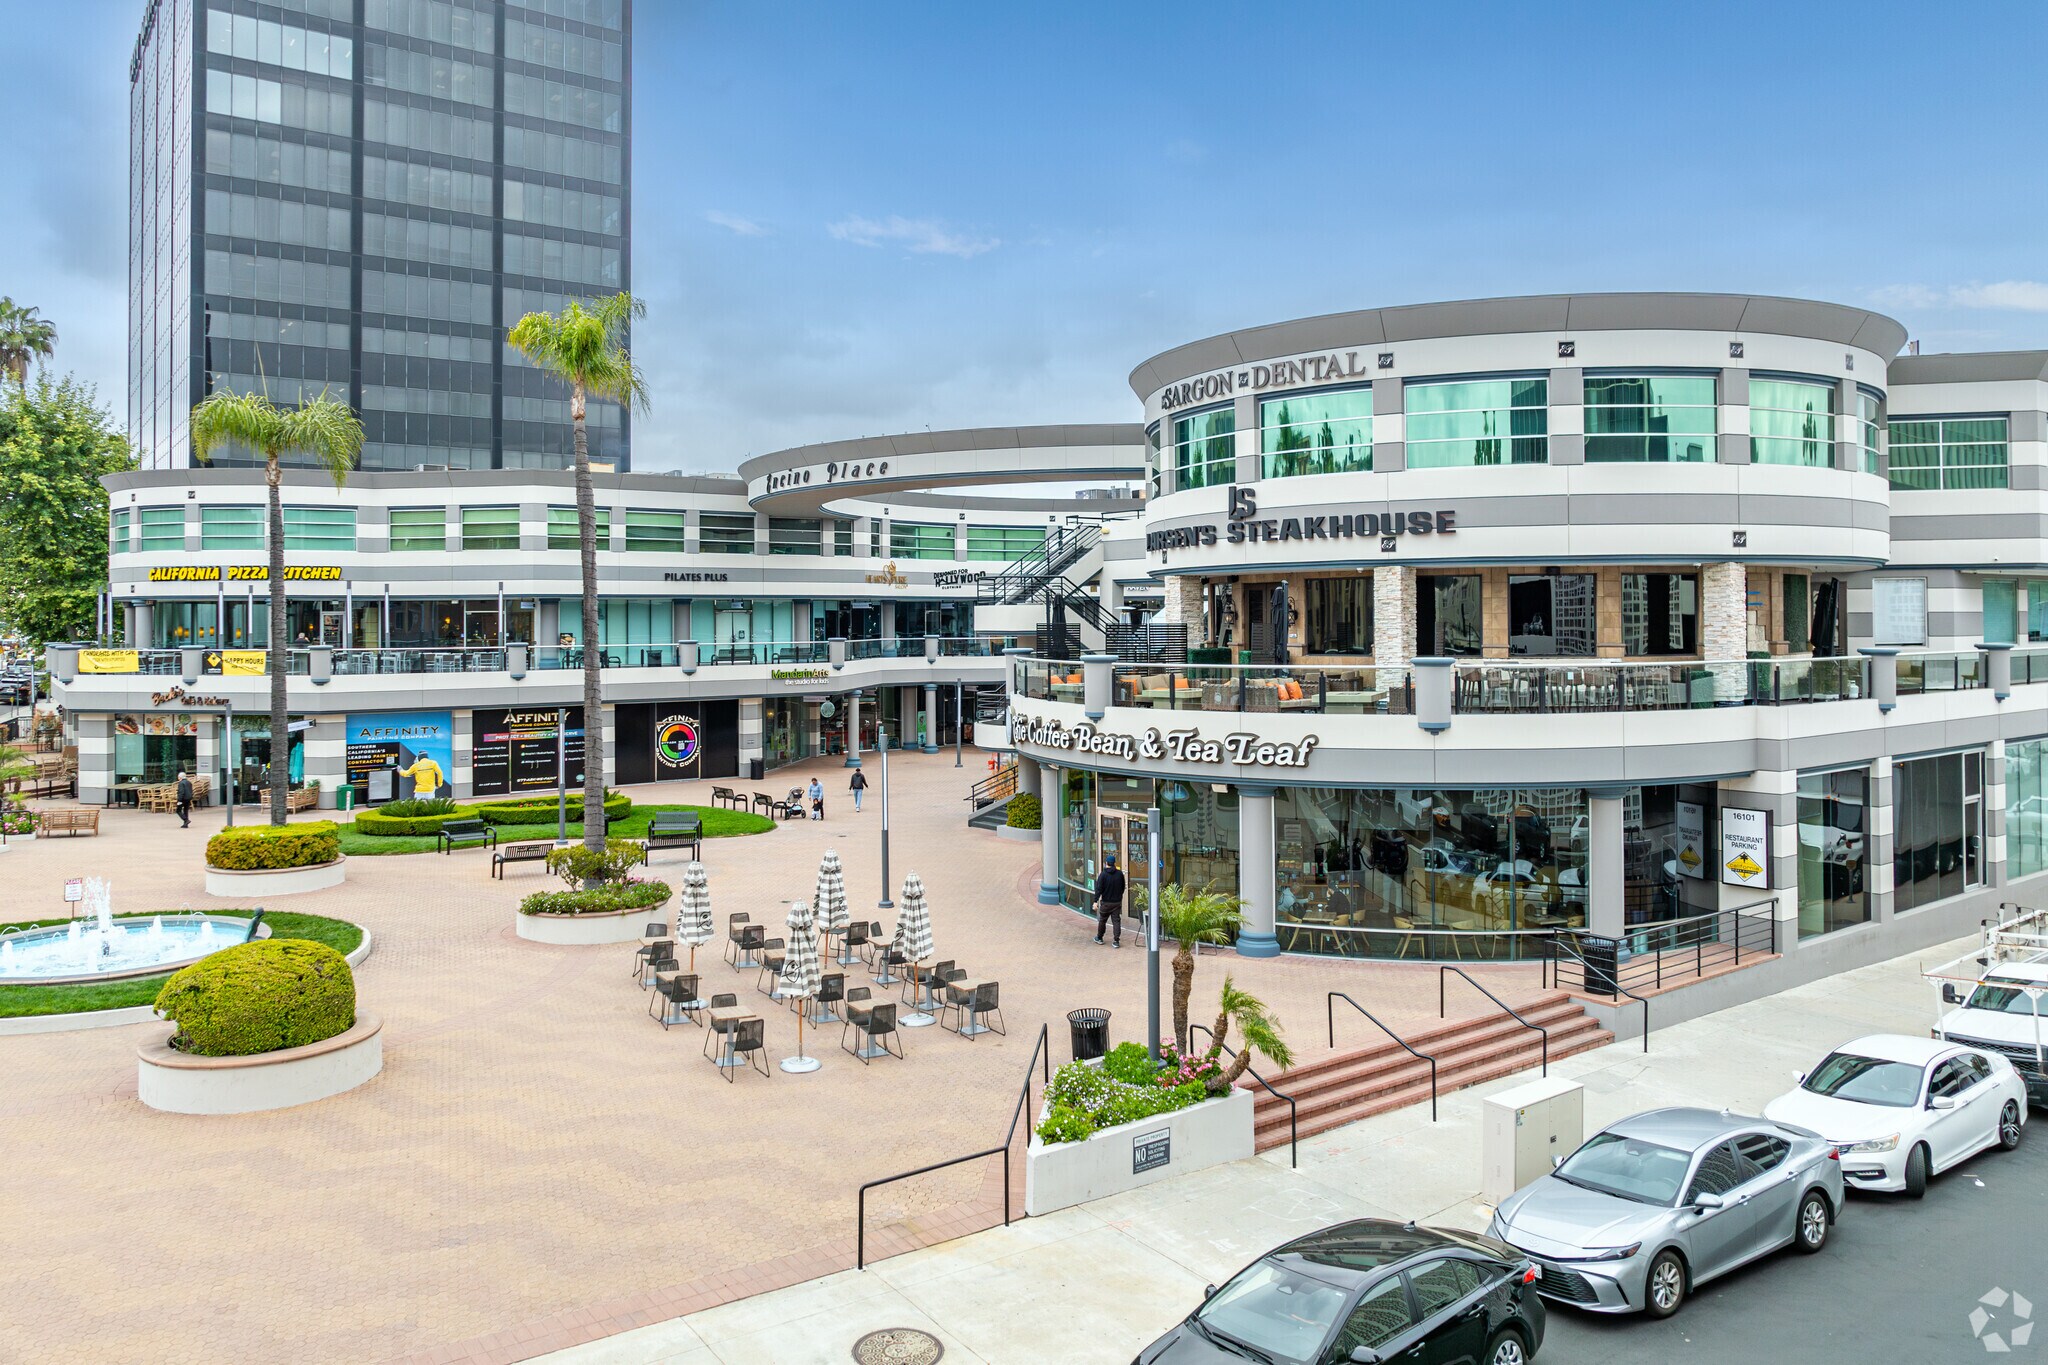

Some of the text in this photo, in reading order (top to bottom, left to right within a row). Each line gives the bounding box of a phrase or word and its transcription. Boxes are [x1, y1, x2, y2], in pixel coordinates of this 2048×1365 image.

[1161, 351, 1366, 410] SARGON DENTAL
[766, 461, 888, 494] Encino Place
[1146, 510, 1456, 551] LARSEN'S STEAKHOUSE
[148, 566, 343, 581] CALIFORNIA PIZZA KITCHEN
[664, 572, 728, 582] PILATES PLUS
[933, 570, 958, 579] DESIGNED
[935, 571, 987, 588] HOLLYWOOD
[245, 657, 264, 665] HOURS
[771, 668, 829, 679] MandarinArts
[502, 712, 571, 724] AFFINITY
[360, 726, 440, 737] AFFINITY
[1027, 716, 1075, 750] Coffee
[1072, 721, 1138, 763] Bean
[1139, 727, 1168, 760] &
[1165, 726, 1225, 764] Tea
[1224, 731, 1320, 768] Leaf
[1733, 812, 1755, 821] 16101
[1725, 833, 1764, 844] RESTAURANT
[1731, 841, 1758, 851] PARKING
[1135, 1131, 1168, 1144] PRIVATE PROPERTY
[1147, 1139, 1170, 1149] TRESPASSING
[1135, 1148, 1147, 1163] NO
